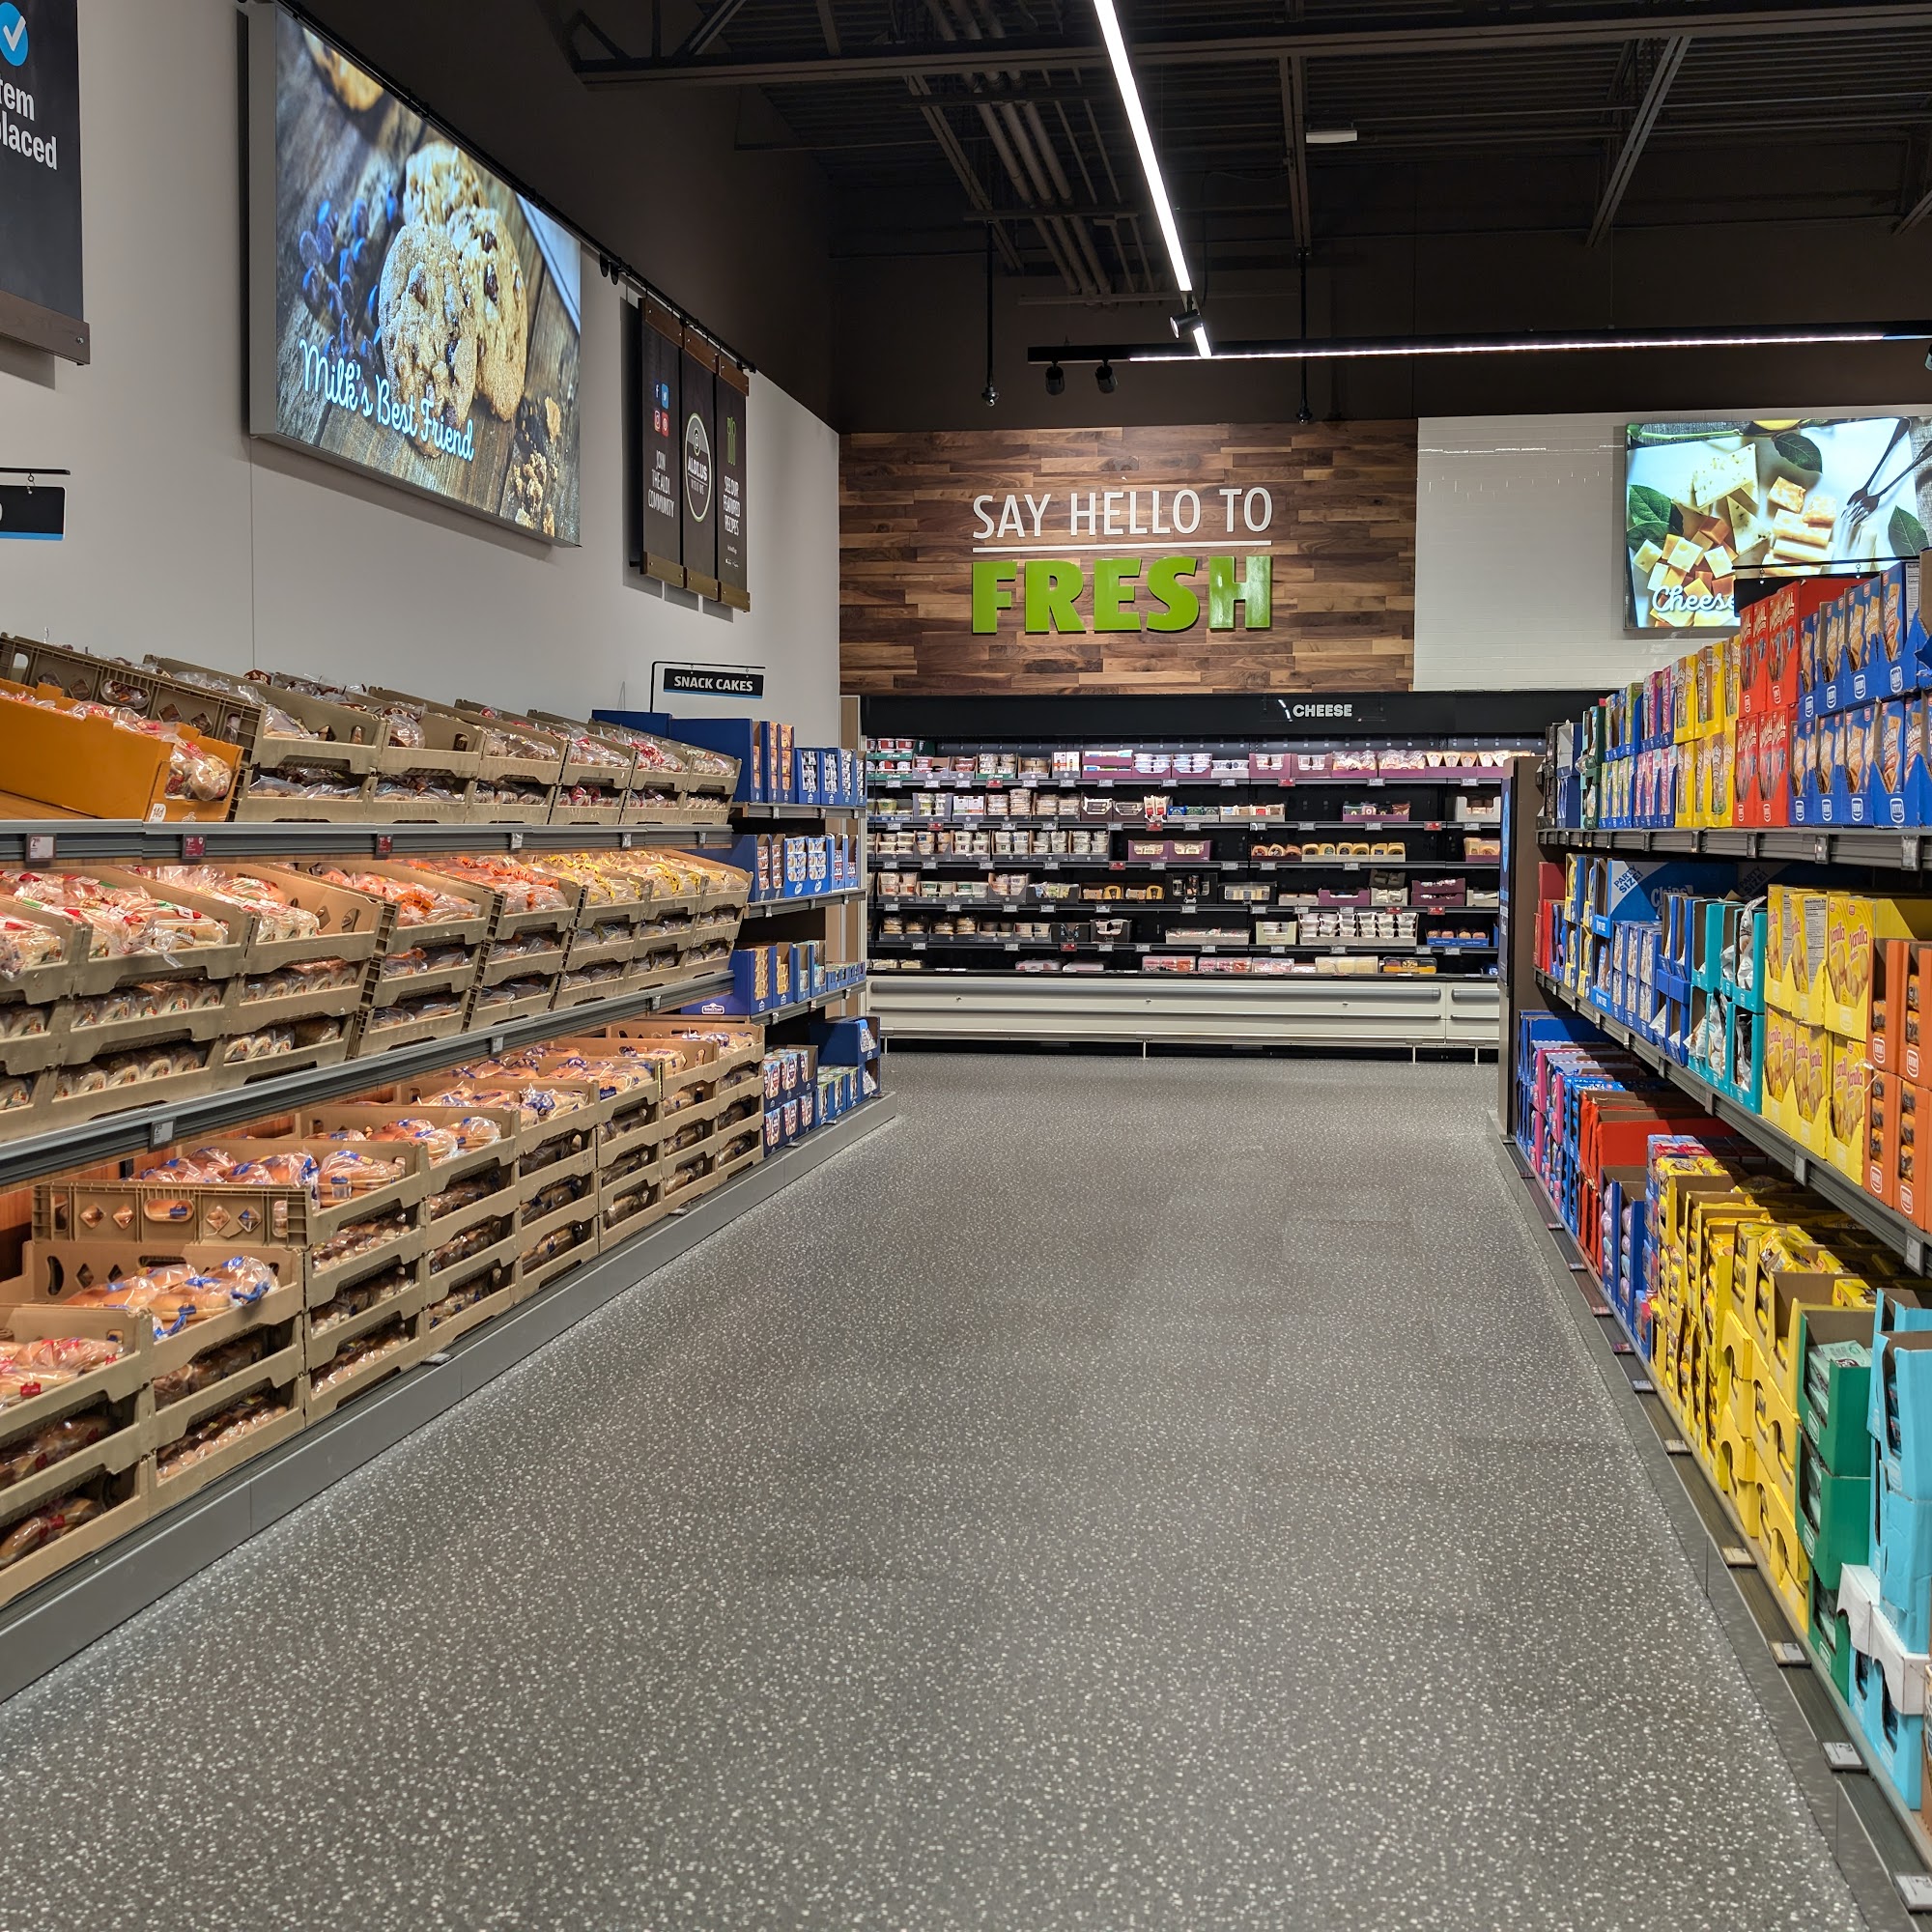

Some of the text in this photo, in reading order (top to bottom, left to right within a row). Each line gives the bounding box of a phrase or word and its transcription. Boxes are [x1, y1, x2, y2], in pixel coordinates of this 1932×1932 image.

[0, 110, 58, 171] laced
[299, 338, 475, 462] Milk's Best Friend
[972, 487, 1272, 539] SAY HELLO TO
[972, 555, 1272, 634] FRESH
[674, 675, 753, 692] SNACK CAKES
[1293, 703, 1352, 718] CHEESE
[1613, 866, 1636, 887] PARTY
[1618, 870, 1644, 894] SIZE!
